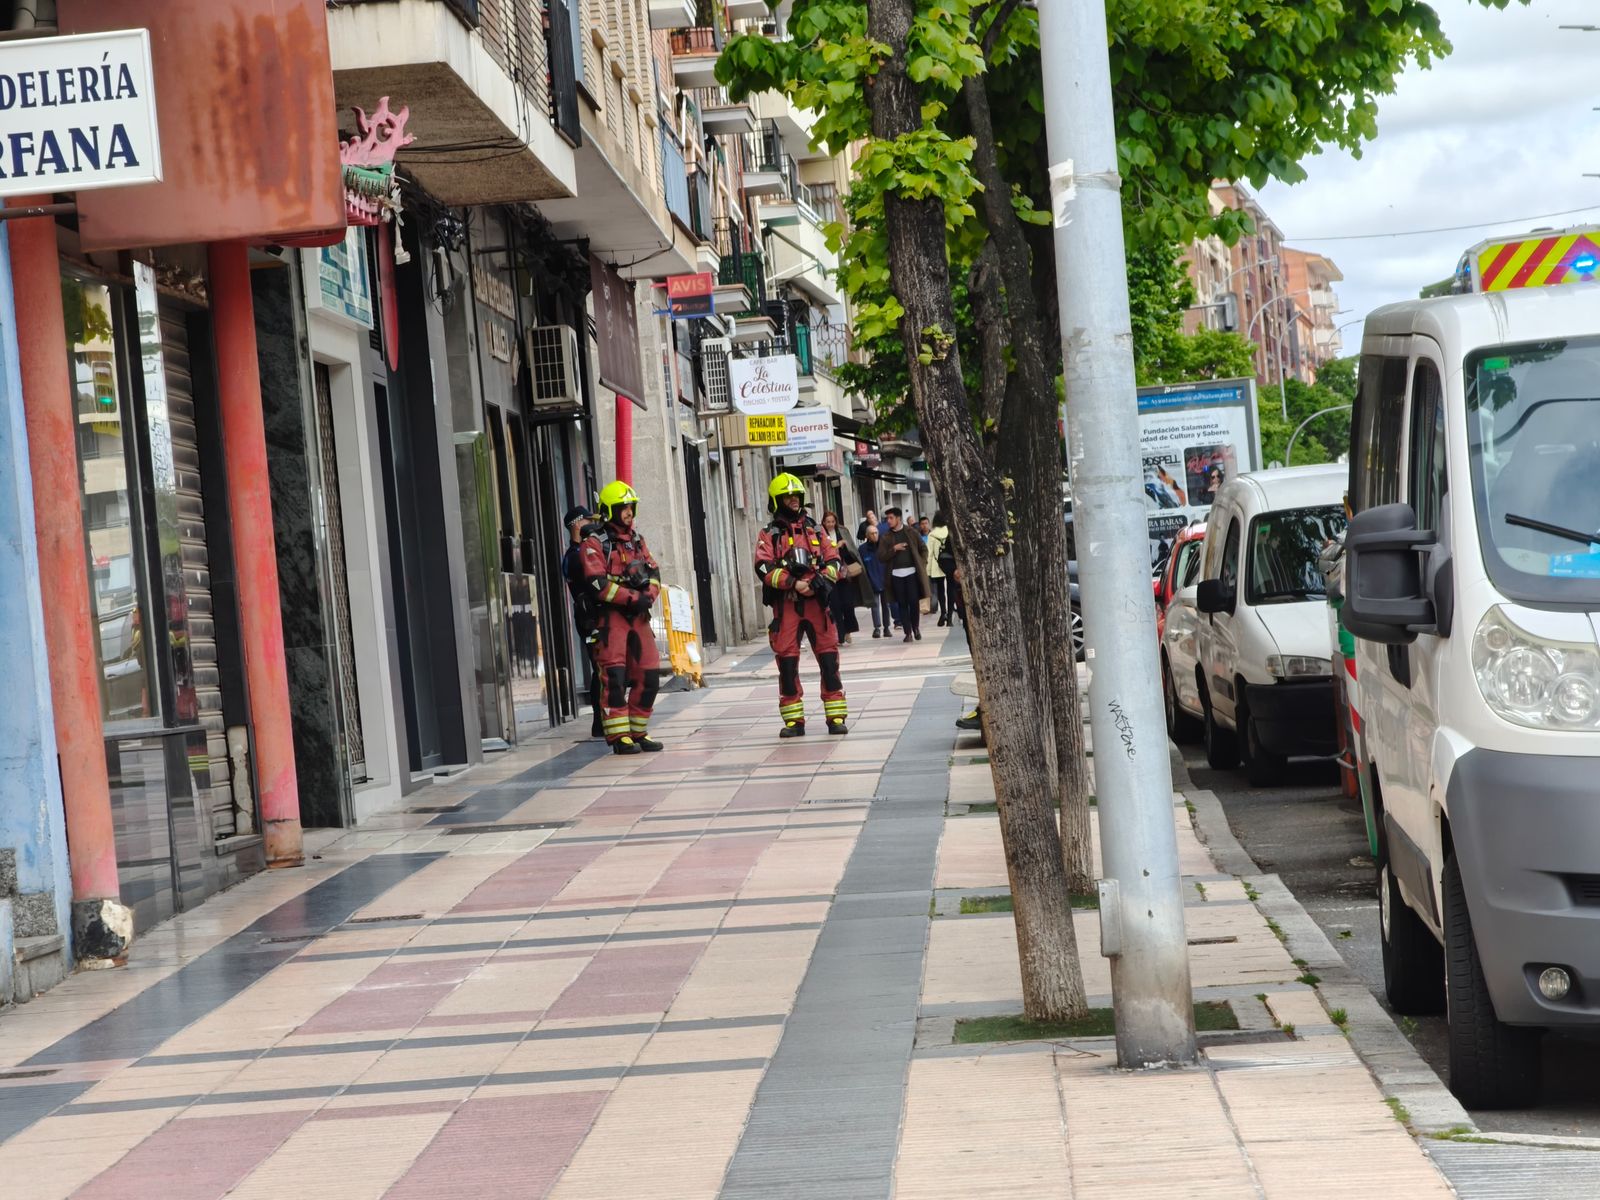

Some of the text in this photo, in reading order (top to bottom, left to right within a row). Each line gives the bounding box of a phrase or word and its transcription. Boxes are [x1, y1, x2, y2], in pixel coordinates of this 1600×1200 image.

[671, 278, 706, 293] AVIS
[754, 365, 769, 382] La
[739, 381, 793, 398] Celestina
[790, 423, 829, 433] Guerras
[1143, 423, 1219, 435] Fundación Salamanca
[1169, 432, 1195, 440] Cultura
[1202, 429, 1230, 437] Saberes
[1160, 518, 1184, 526] BARAS
